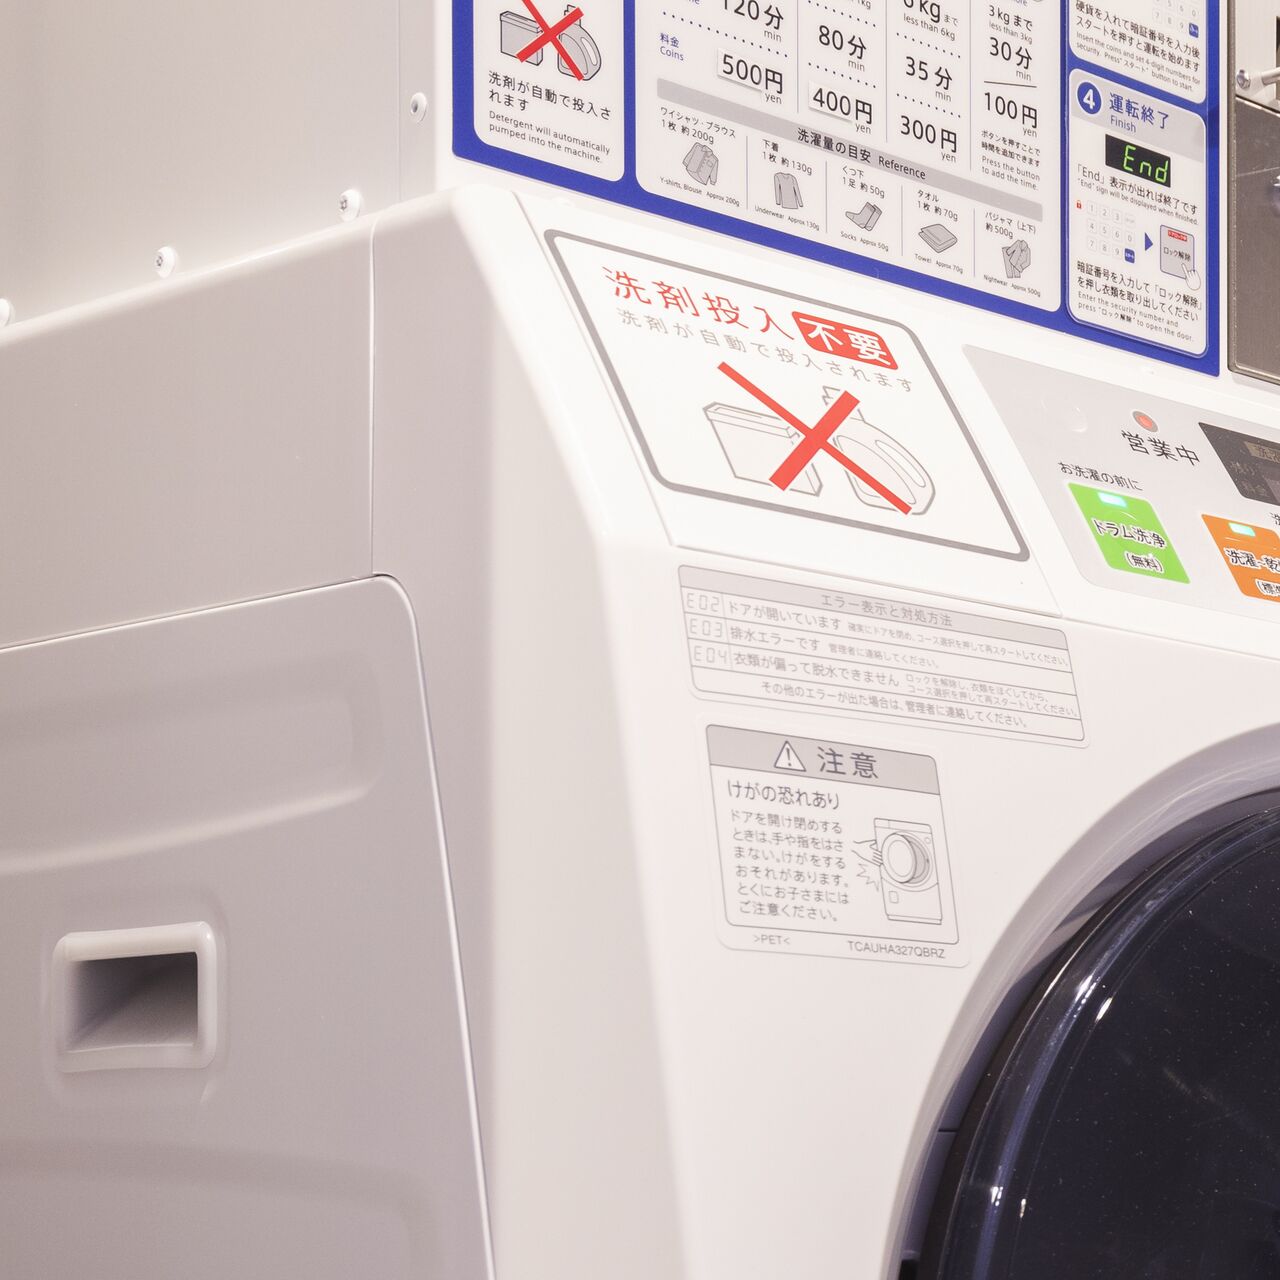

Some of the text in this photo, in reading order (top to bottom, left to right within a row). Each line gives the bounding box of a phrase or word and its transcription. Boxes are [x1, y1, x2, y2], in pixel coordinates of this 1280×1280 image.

[764, 30, 782, 42] min
[904, 13, 956, 41] less than 6kg
[989, 22, 1032, 44] less than 3kg
[660, 33, 680, 48] 料金
[818, 25, 866, 60] 80分
[1076, 16, 1200, 72] スタートを押すと運転を始めます
[660, 46, 684, 61] Coins
[990, 37, 1032, 70] 30分
[1076, 32, 1191, 80] Insert coins numbers
[723, 54, 783, 94] 500円
[848, 60, 866, 72] min
[905, 56, 952, 90] 35分
[1016, 68, 1032, 82] min
[1152, 69, 1170, 82] button
[488, 70, 611, 120] 洗剤が自動で投入さ
[489, 89, 529, 111] れます
[764, 92, 782, 104] yen
[813, 88, 872, 125] 400円
[935, 89, 952, 102] min
[660, 106, 736, 138] ワイシャツ・ブラウス
[985, 92, 1038, 129] 100円
[1109, 92, 1169, 130] 運転終了
[490, 110, 610, 156] Detergent will automatically
[682, 126, 714, 145] 約200g
[855, 122, 872, 134] yen
[900, 115, 957, 154] 300円
[1022, 126, 1038, 138] yen
[1110, 115, 1136, 132] Finish
[489, 123, 602, 163] pumped into the machine.
[762, 139, 779, 152] 下着
[798, 127, 926, 180] 洗濯量の目安 Reference
[982, 130, 1040, 156] ボタンを押すことで
[982, 141, 1040, 167] 時間を追加できます
[781, 156, 812, 176] 約130g
[940, 151, 956, 163] yen
[982, 156, 1040, 181] Press button
[1123, 145, 1169, 183] End
[842, 165, 864, 178] くつ下
[684, 184, 724, 204] Blouse Approx
[860, 182, 884, 199] 約50g
[918, 189, 939, 202] タオル
[1020, 179, 1038, 190] time.
[934, 206, 958, 222] 約70g
[1130, 196, 1156, 211] displayed
[755, 206, 805, 228] Underwear Approx
[840, 231, 878, 248] Socks Approx
[986, 222, 1014, 240] 約500g
[914, 254, 952, 270] Towel Approx
[1164, 247, 1190, 262] ロック解除
[984, 274, 1008, 288] Nightwear
[1078, 276, 1198, 320] を押し衣類を取り出してください
[1078, 290, 1164, 322] Enter security number
[1078, 302, 1162, 333] press open
[616, 308, 912, 392] 洗剤が自動で投入されます
[1120, 430, 1200, 466] 営業中
[1058, 462, 1143, 492] お洗濯の前に
[1094, 518, 1166, 548] ドラム洗浄
[1126, 553, 1163, 572] (無料)
[687, 593, 720, 612] E02
[729, 602, 841, 630] ドアが開いています
[822, 594, 952, 626] エラー表示と対処方法
[690, 618, 939, 668] E03 排水エラーです 管理者に連絡してください。
[694, 645, 728, 664] E04
[734, 653, 898, 687] 衣類が偏って脱水できません
[909, 684, 1078, 718] コース選択を押して再スタートしてください。
[816, 746, 879, 780] 注意
[728, 780, 840, 810] けがの恐れあり
[731, 808, 842, 835] ドアを開け閉めする
[733, 828, 844, 854] ときは、手や指をはさ
[734, 846, 846, 870] まない。けがをする
[736, 864, 848, 888] おそれがあります。
[738, 882, 849, 906] とくにお子さまには
[740, 900, 838, 922] ご注意ください。
[754, 933, 790, 946] >PET<
